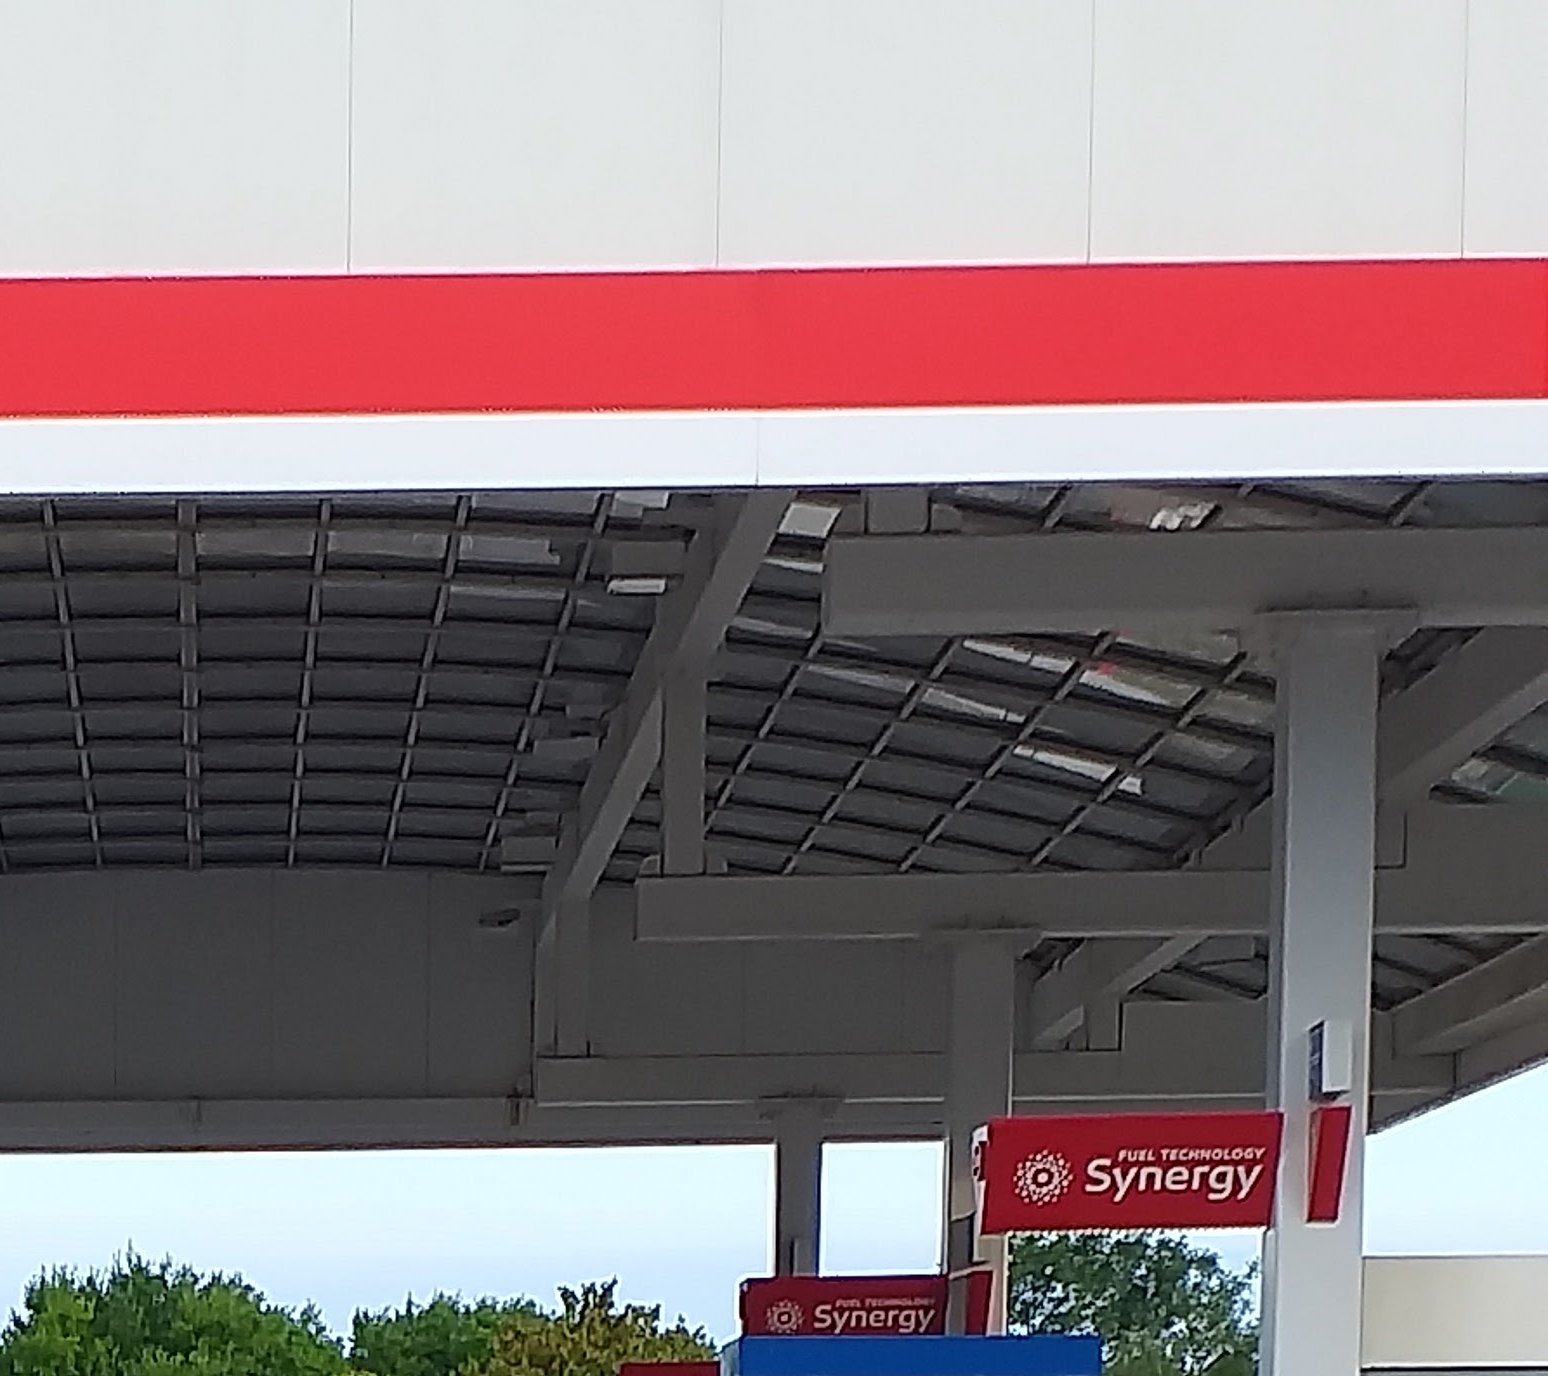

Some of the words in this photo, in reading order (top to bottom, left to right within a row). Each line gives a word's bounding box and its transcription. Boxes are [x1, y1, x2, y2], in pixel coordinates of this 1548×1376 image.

[1118, 1148, 1155, 1163] FUEL
[1160, 1147, 1267, 1162] TECHNOLOGY
[1084, 1157, 1264, 1202] Synergy
[813, 1303, 937, 1334] Synergy
